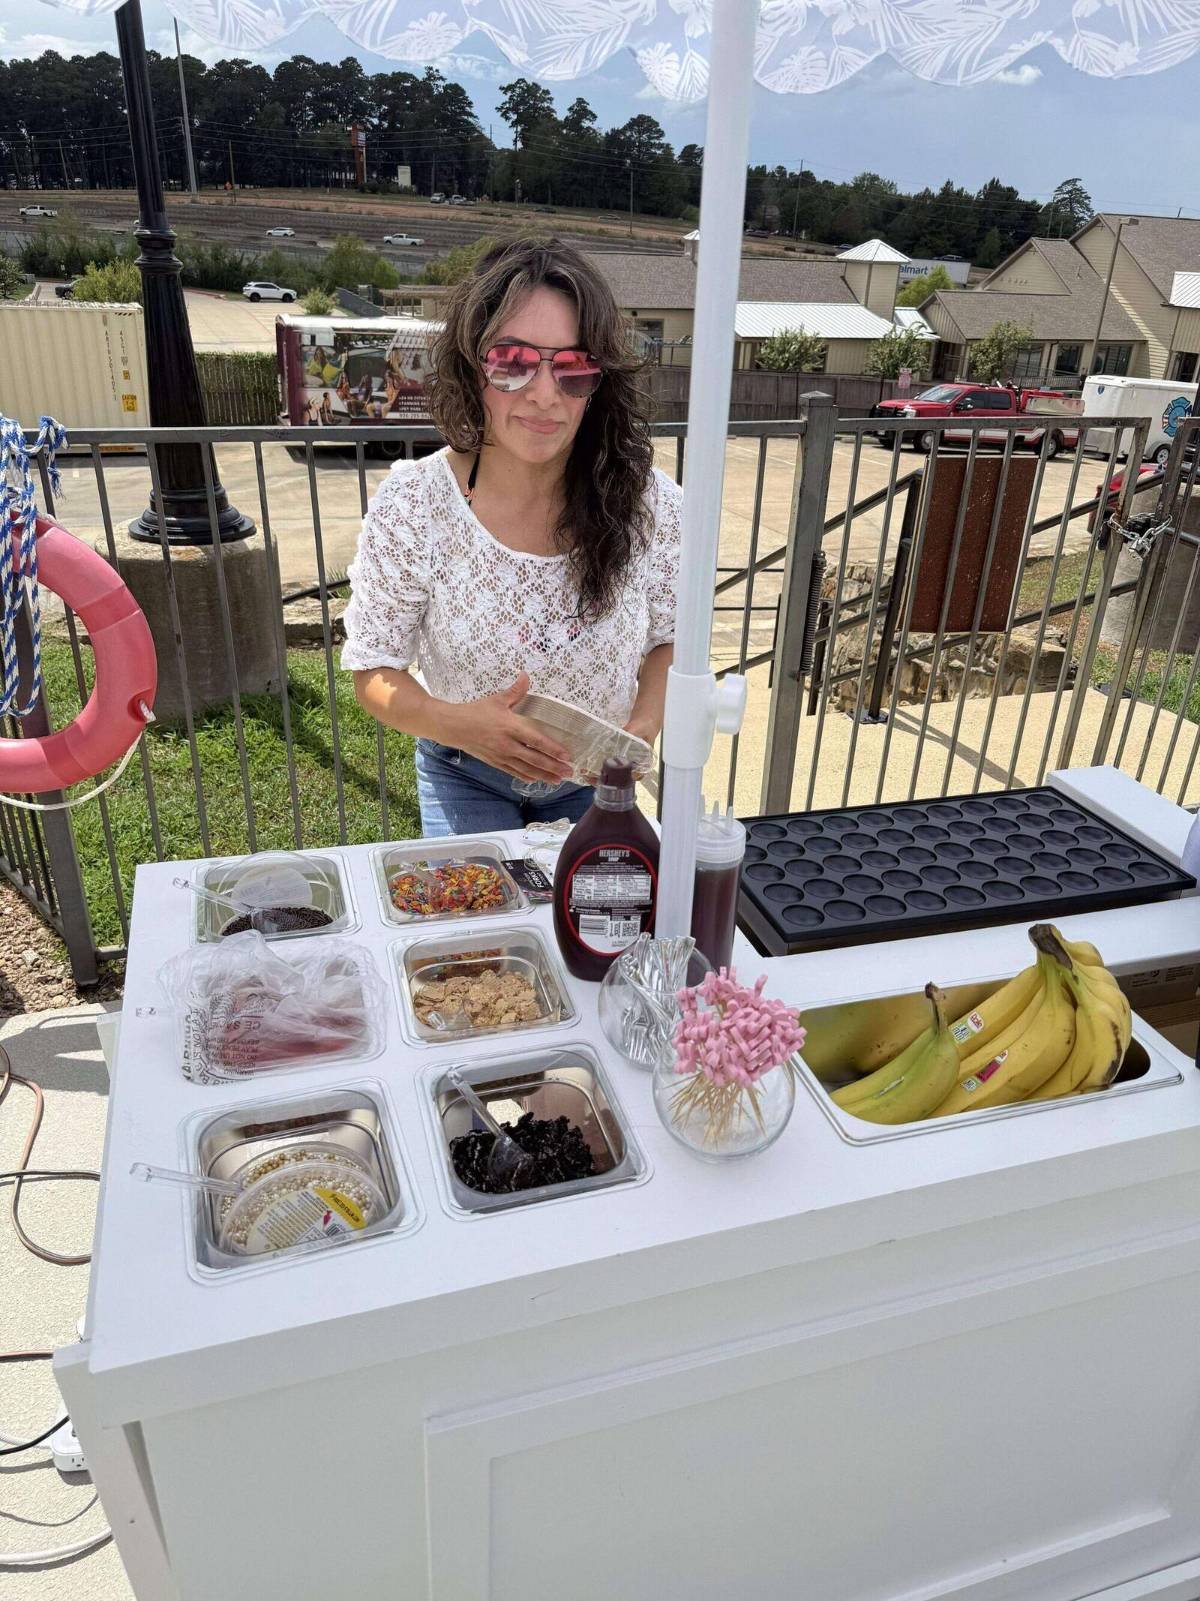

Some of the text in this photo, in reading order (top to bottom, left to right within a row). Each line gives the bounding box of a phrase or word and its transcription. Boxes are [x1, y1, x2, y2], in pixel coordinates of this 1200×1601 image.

[899, 264, 928, 275] almart
[599, 849, 630, 858] HERSHEY'S
[528, 871, 545, 888] FORKS
